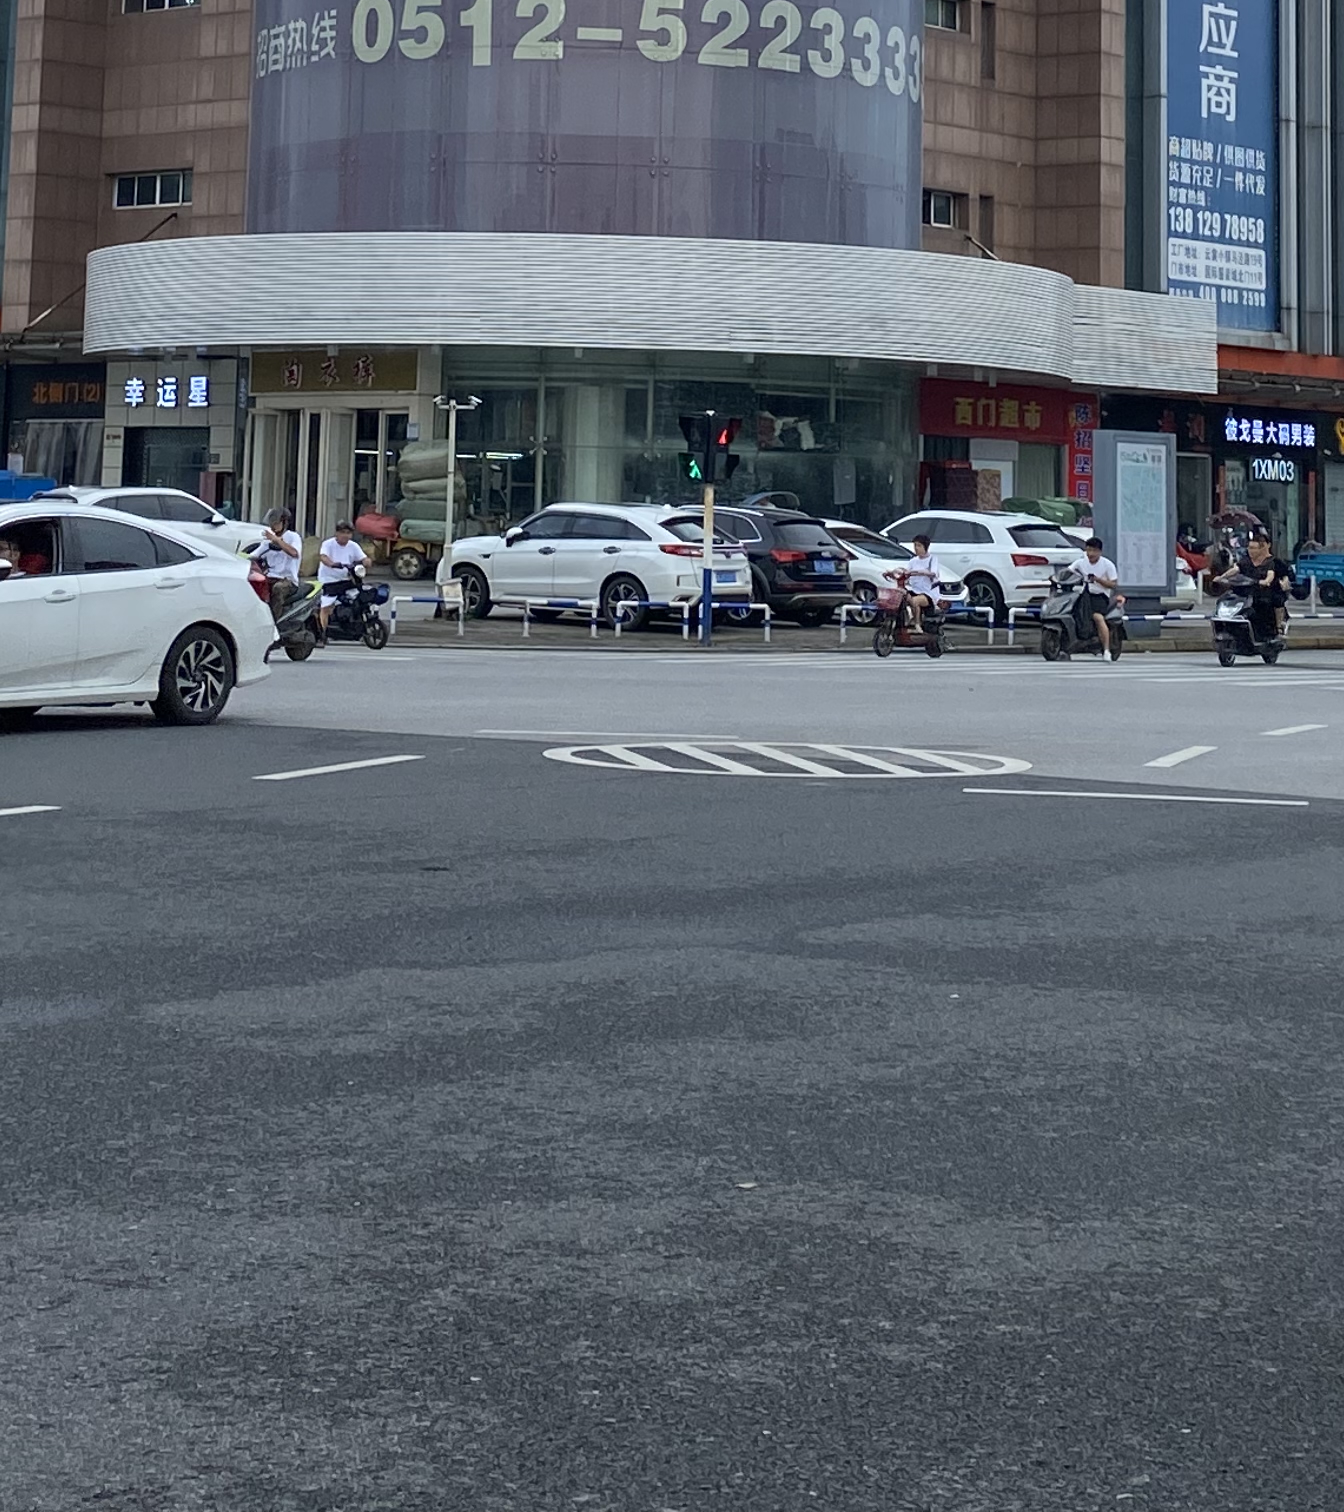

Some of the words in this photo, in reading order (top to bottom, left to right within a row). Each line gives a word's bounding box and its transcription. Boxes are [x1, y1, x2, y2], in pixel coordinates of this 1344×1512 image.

[1197, 210, 1221, 237] 129
[124, 376, 209, 407] 幸运星
[955, 397, 1043, 431] 西门超市
[1252, 458, 1295, 482] 1XM03
